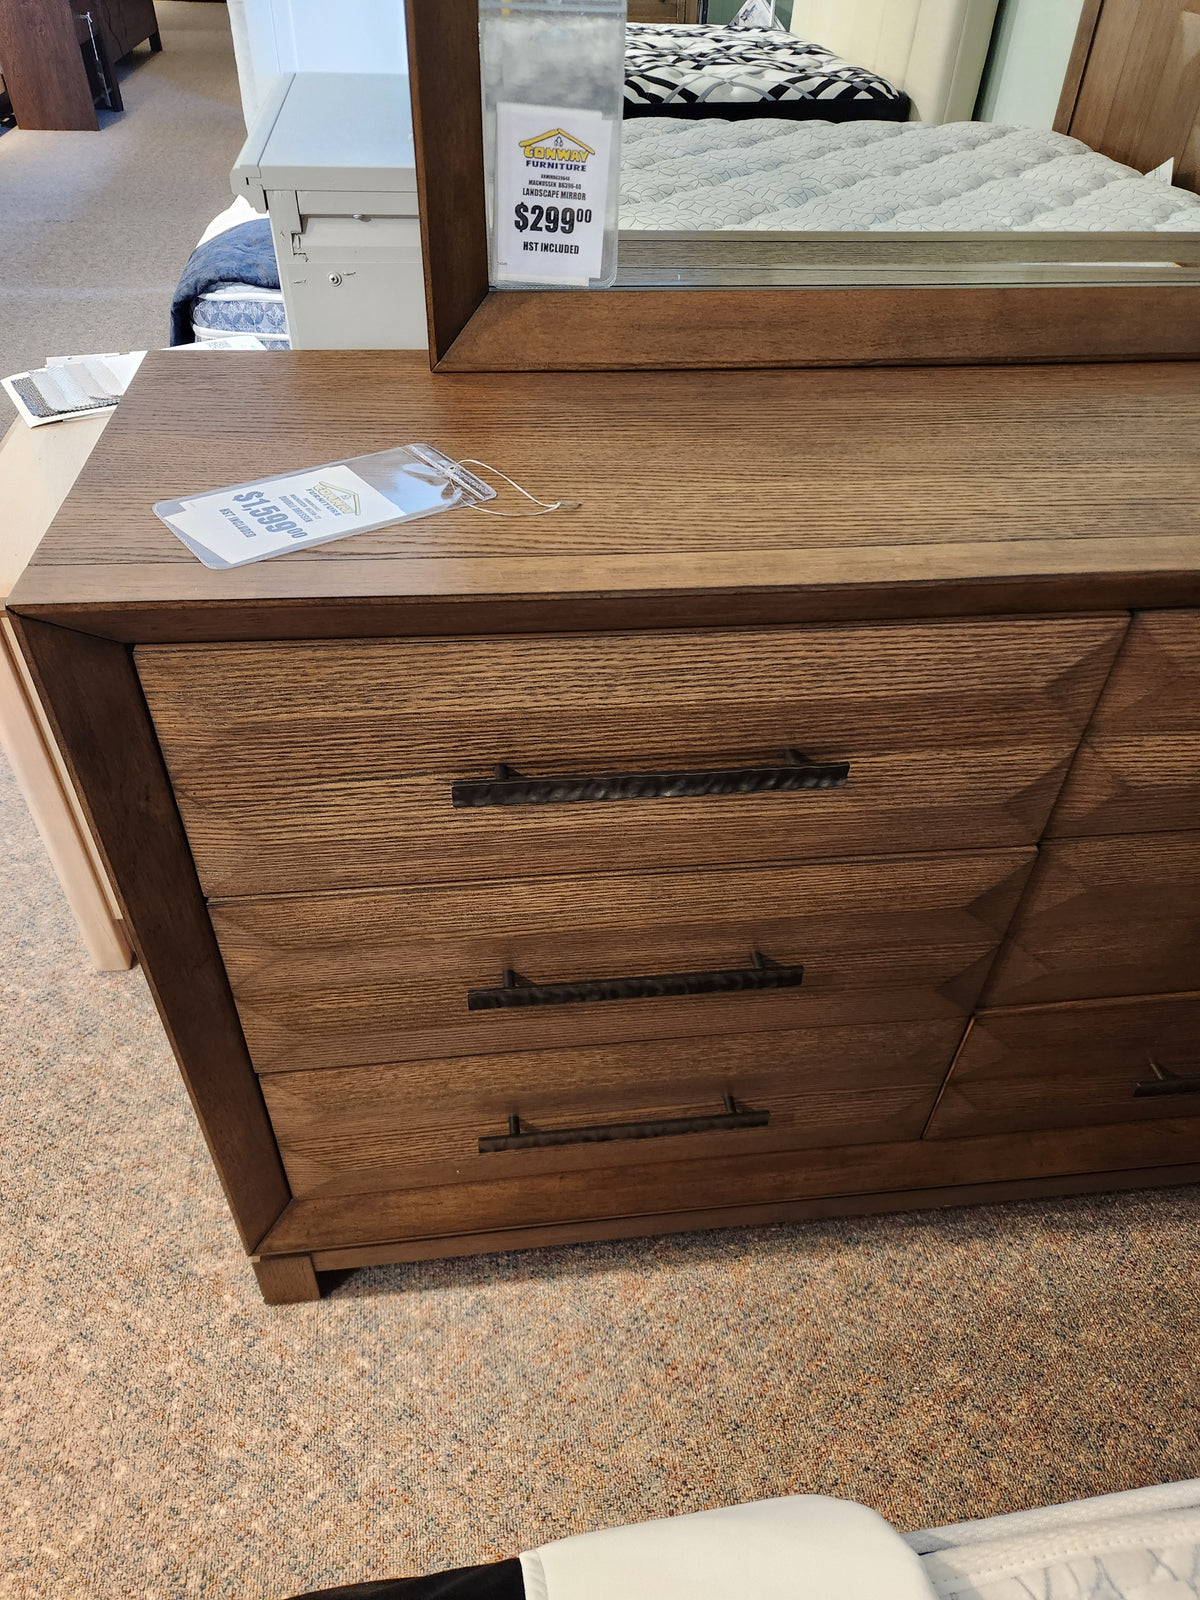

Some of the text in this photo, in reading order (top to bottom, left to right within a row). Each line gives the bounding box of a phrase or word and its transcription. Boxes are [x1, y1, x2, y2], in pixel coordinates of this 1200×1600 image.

[524, 146, 589, 163] CONWAY
[525, 160, 587, 172] FURNITURE
[522, 187, 587, 201] LANDSCAPE MIRROR
[523, 241, 580, 255] HST INCLUDED
[305, 488, 342, 517] FURNITURE
[313, 484, 356, 515] CONWAY
[219, 508, 257, 538] HST INCLUDED
